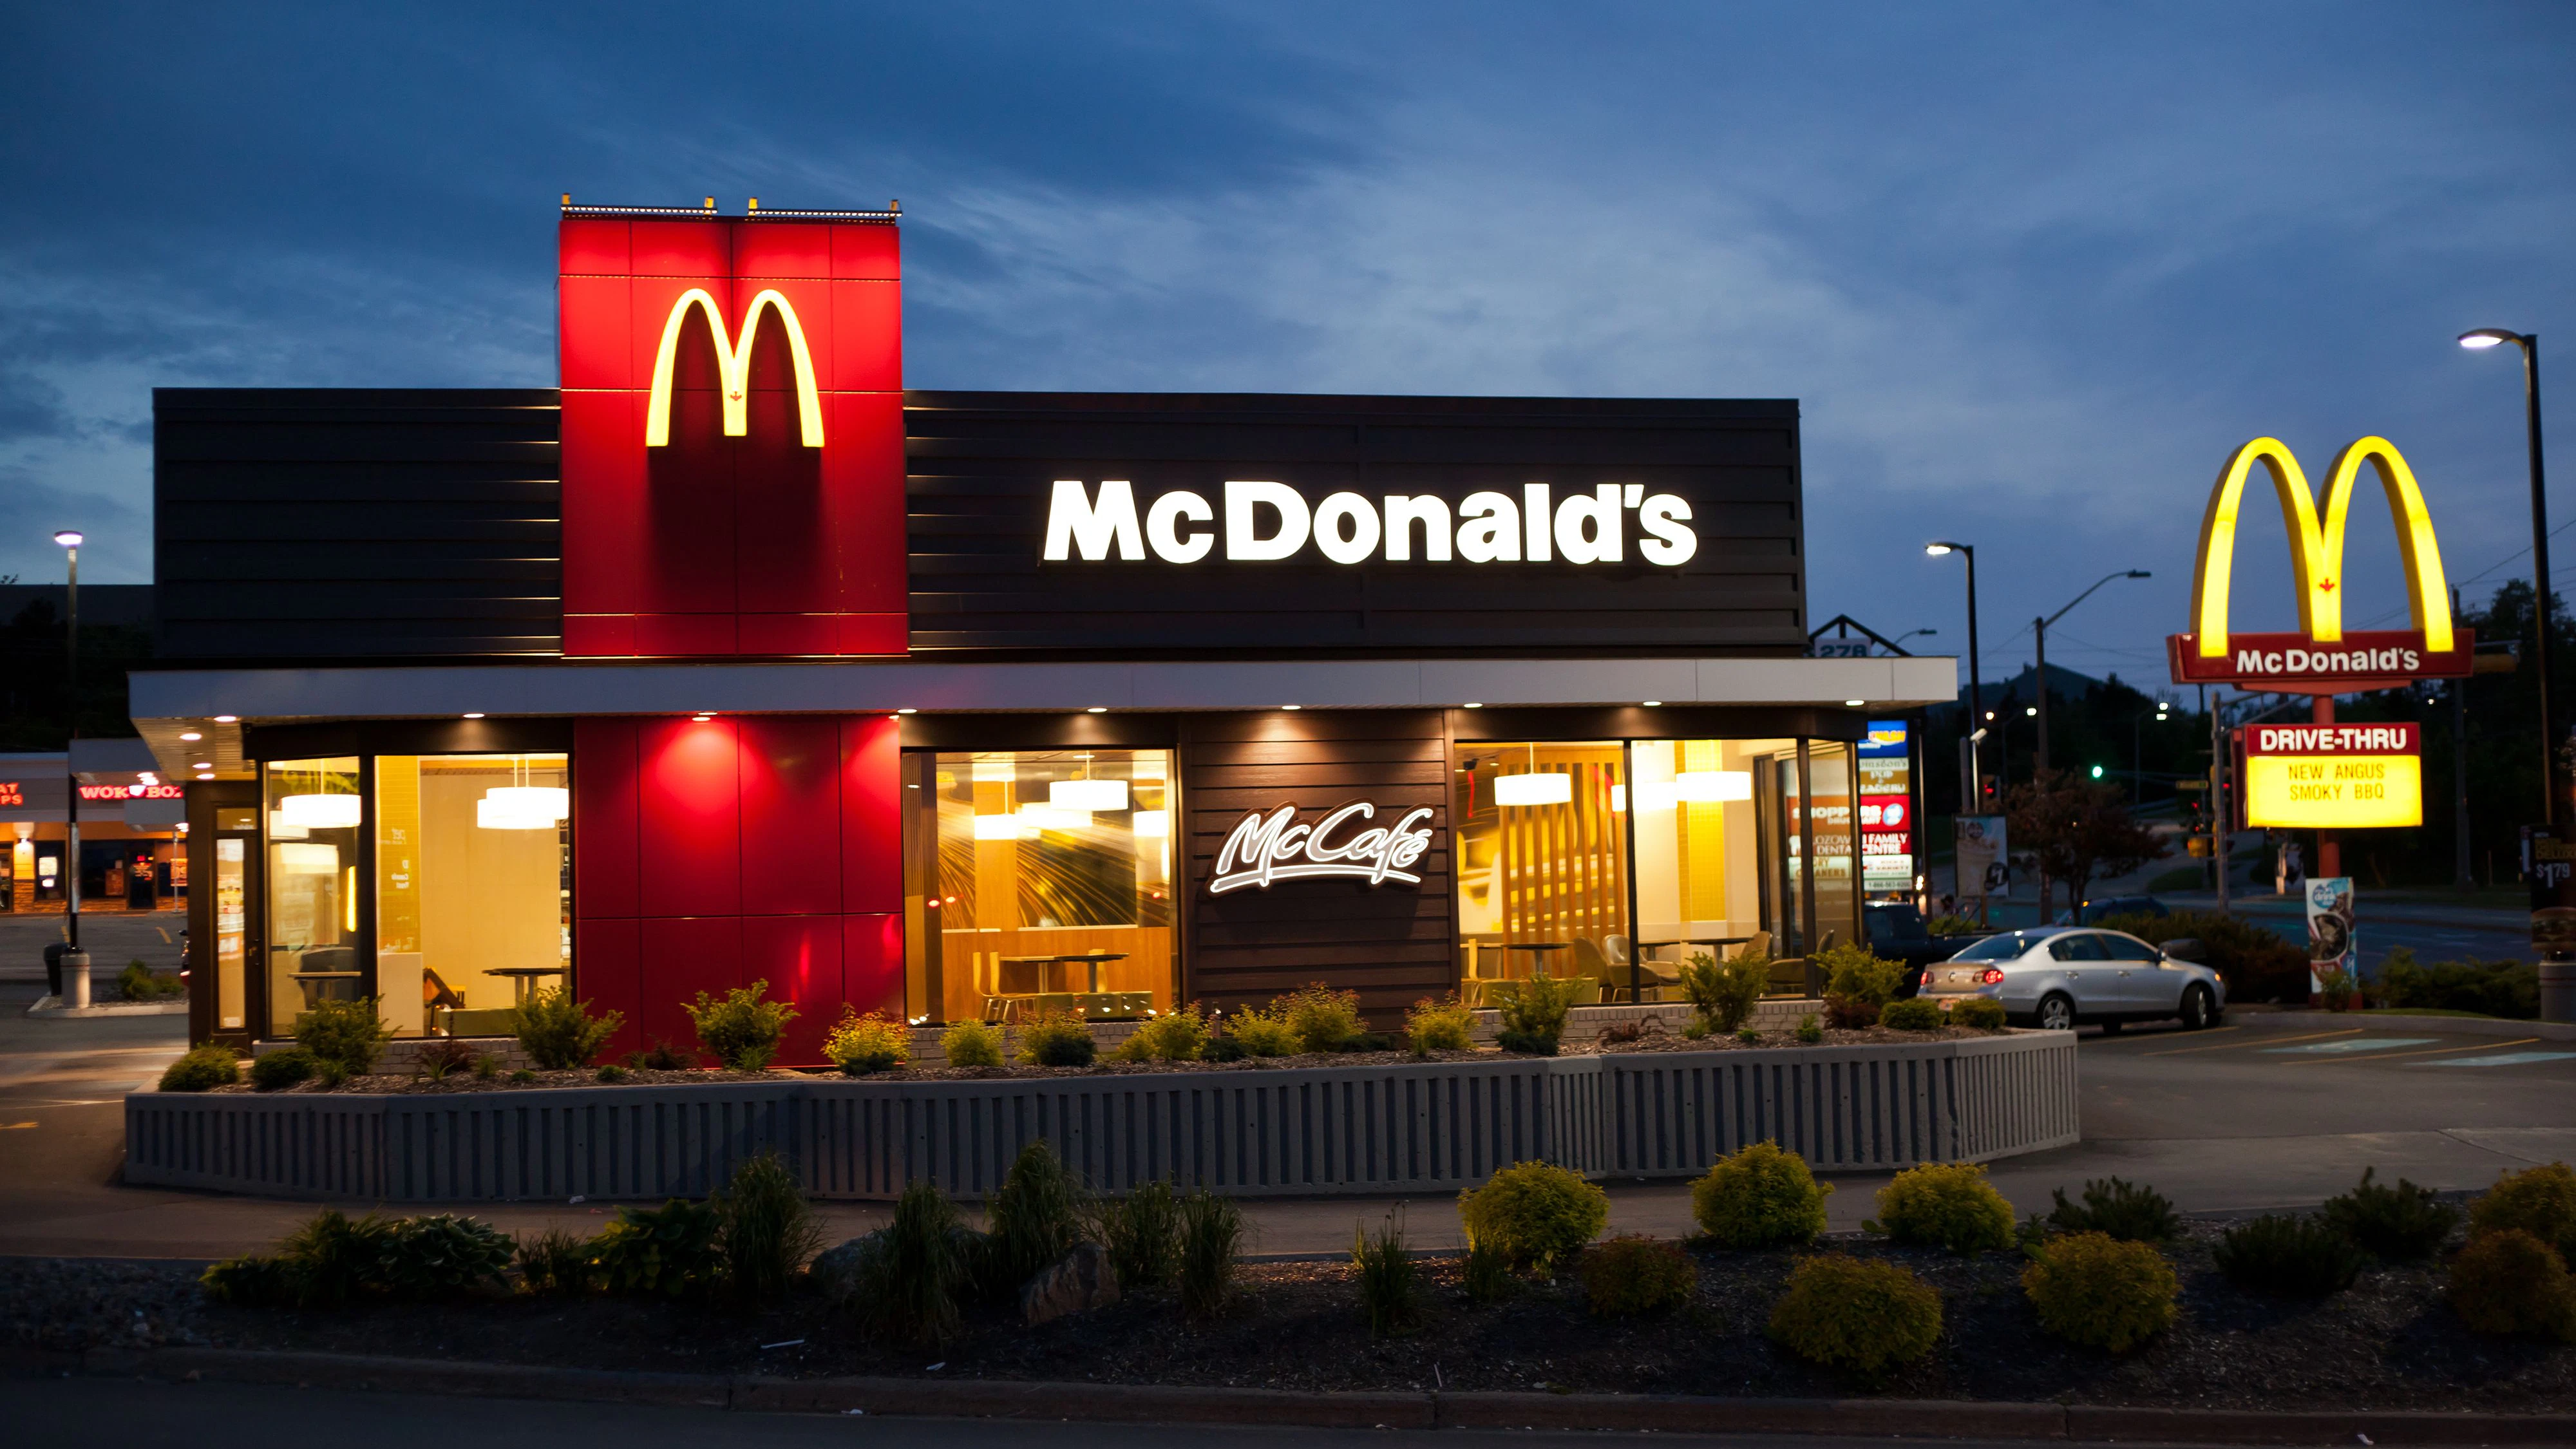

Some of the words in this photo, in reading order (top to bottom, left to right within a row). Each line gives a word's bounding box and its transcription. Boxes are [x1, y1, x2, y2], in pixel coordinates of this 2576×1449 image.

[1043, 480, 1698, 566] McDonald's
[2236, 647, 2420, 674] McDonald's
[2260, 728, 2407, 752] DRIVE-THRU
[2288, 764, 2323, 779] NEW
[2334, 763, 2385, 779] ANGUS
[80, 786, 129, 799] WOK
[2289, 784, 2341, 800] SMOKY
[2354, 783, 2385, 800] BBQ
[1793, 806, 1881, 819] SOPPRS
[1215, 801, 1434, 887] McCafé
[1869, 833, 1908, 844] FAMILY
[1817, 844, 1852, 855] DENTA
[1862, 844, 1902, 855] CENTRE
[1795, 867, 1845, 876] CANERS
